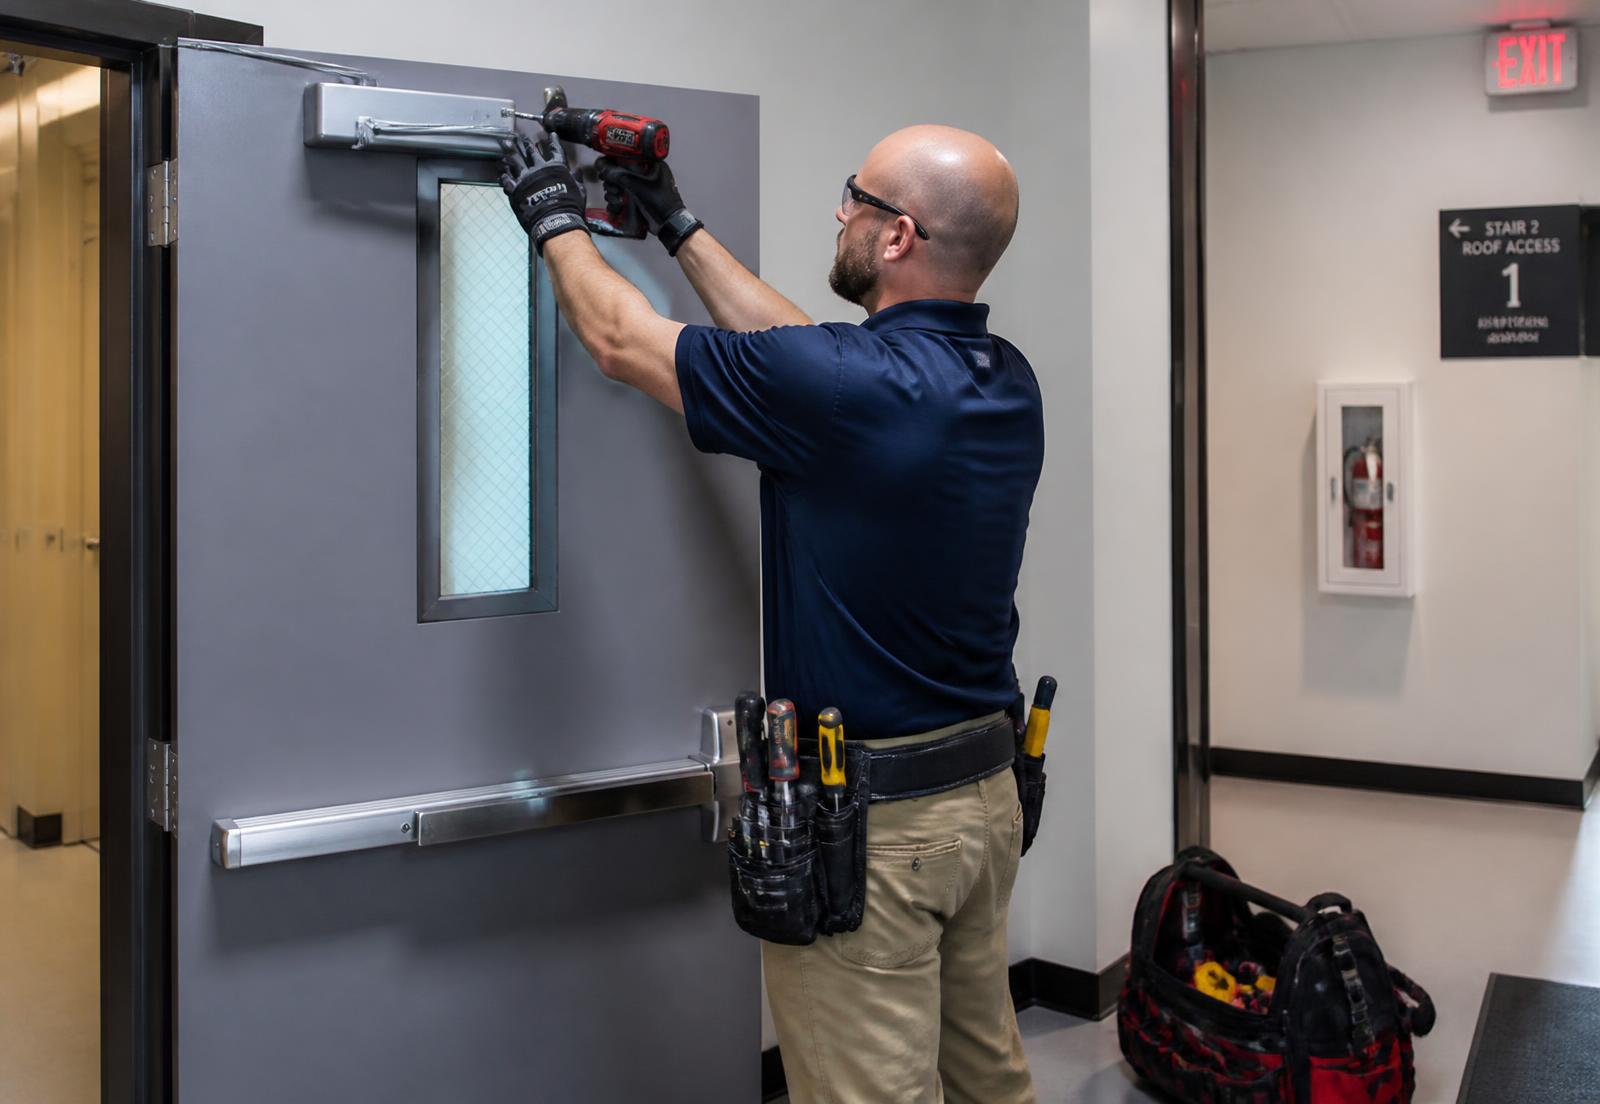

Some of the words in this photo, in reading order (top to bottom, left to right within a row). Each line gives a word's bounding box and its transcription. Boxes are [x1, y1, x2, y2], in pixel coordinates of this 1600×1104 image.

[1498, 33, 1566, 88] EXIT
[1485, 220, 1526, 237] STAIR
[1530, 219, 1540, 234] 2
[1462, 240, 1502, 255] ROOF
[1505, 238, 1560, 254] ACCESS
[1501, 262, 1521, 308] 1
